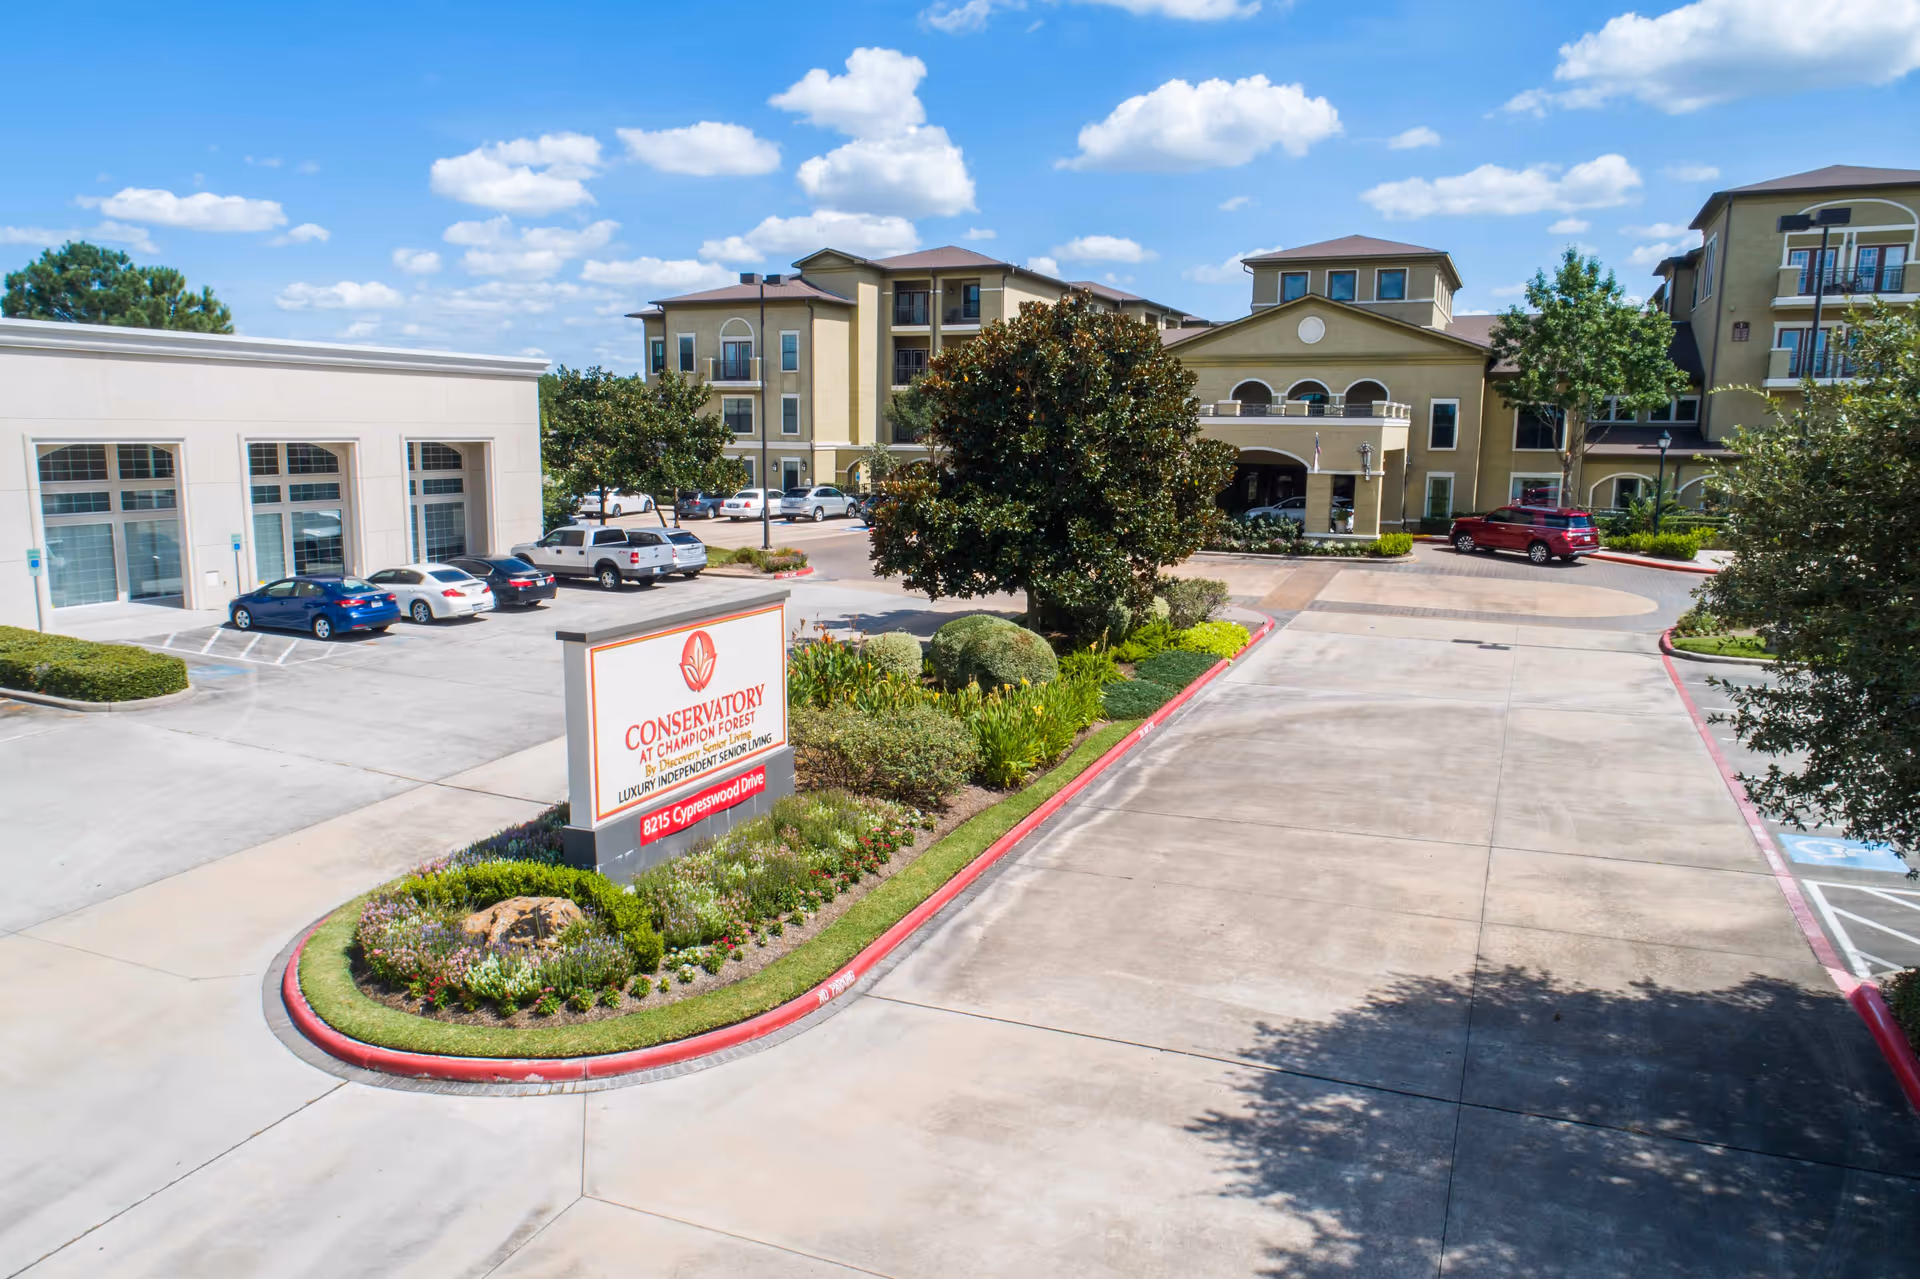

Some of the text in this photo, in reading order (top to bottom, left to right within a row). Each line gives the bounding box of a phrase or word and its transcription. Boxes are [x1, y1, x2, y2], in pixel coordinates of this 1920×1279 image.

[625, 683, 765, 751] CONSERVATORY
[639, 711, 756, 765] AT CHAMPION FOREST
[618, 733, 772, 804] LUXURY INDEPENDENT SENIOR LIVING
[645, 730, 752, 778] By Discovery Senior Living
[643, 773, 764, 836] 8215 Cypresswood Drive
[816, 970, 856, 1005] NO PARKING
